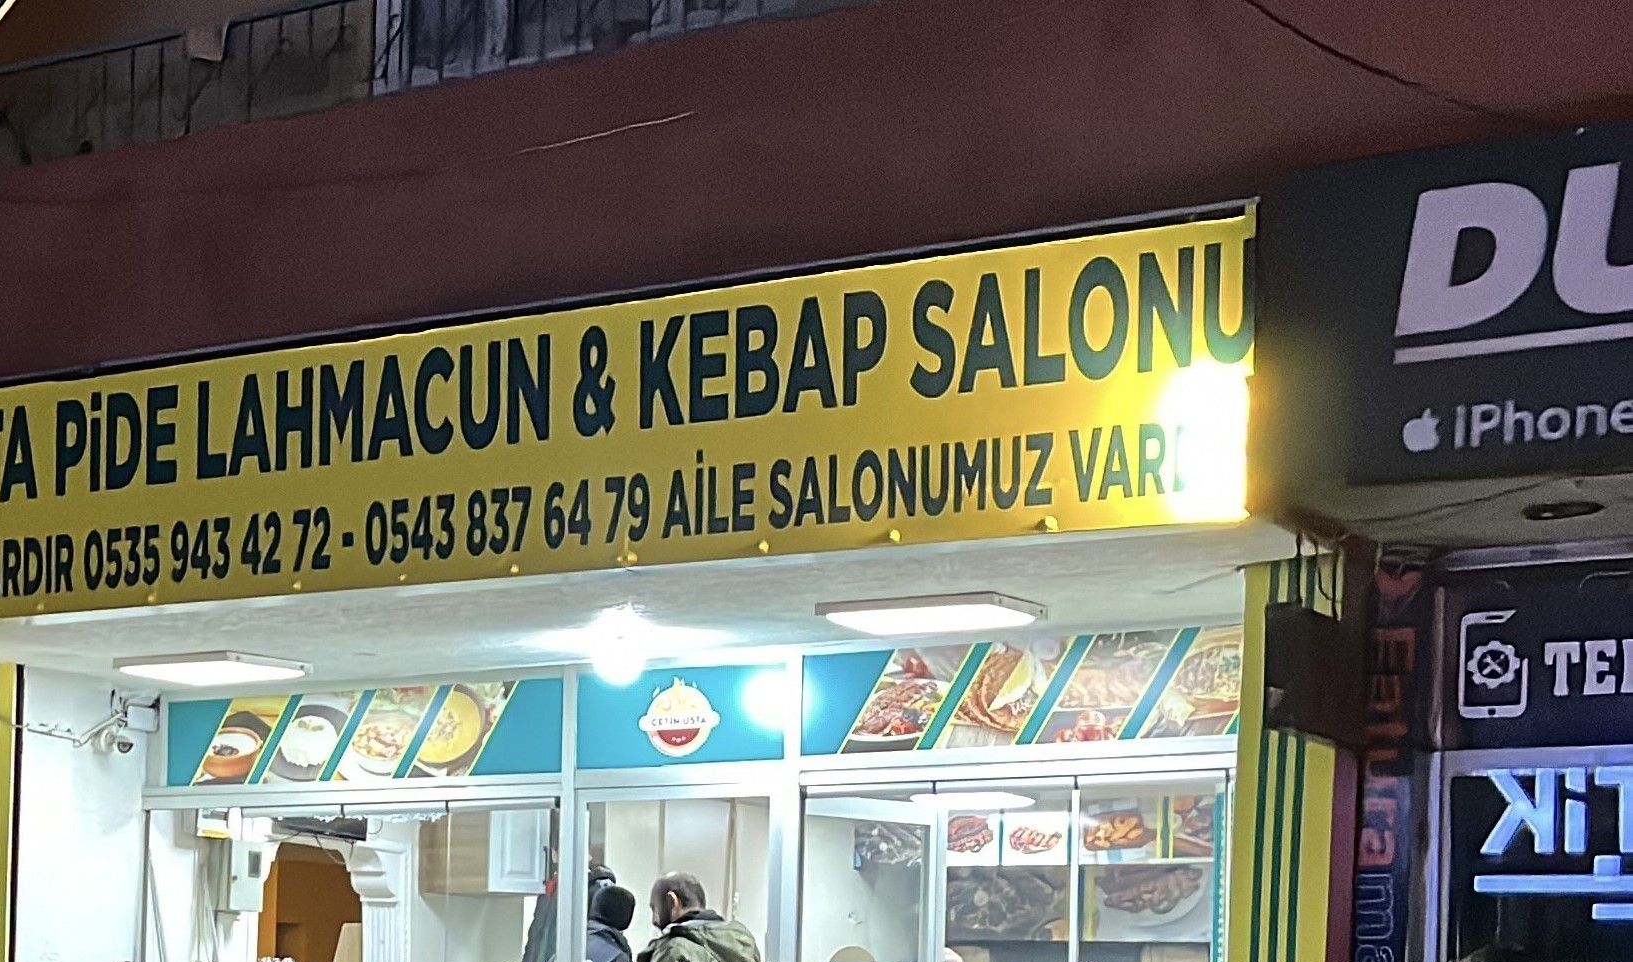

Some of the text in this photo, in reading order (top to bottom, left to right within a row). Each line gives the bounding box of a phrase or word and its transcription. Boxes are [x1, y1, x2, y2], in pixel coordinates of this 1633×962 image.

[197, 334, 551, 480] LAHMACUN
[573, 325, 616, 437] &
[640, 290, 887, 429] KEBAP
[910, 237, 1256, 399] SALONU
[84, 524, 160, 591] 0535
[170, 516, 231, 583] 943
[240, 511, 282, 575] 42
[292, 506, 331, 572] 72
[366, 493, 455, 566] 0543
[466, 486, 532, 556] 837
[543, 479, 591, 550] 64
[604, 472, 650, 544] 79
[662, 449, 755, 538] AİLE
[768, 432, 1054, 529] SALONUMUZ
